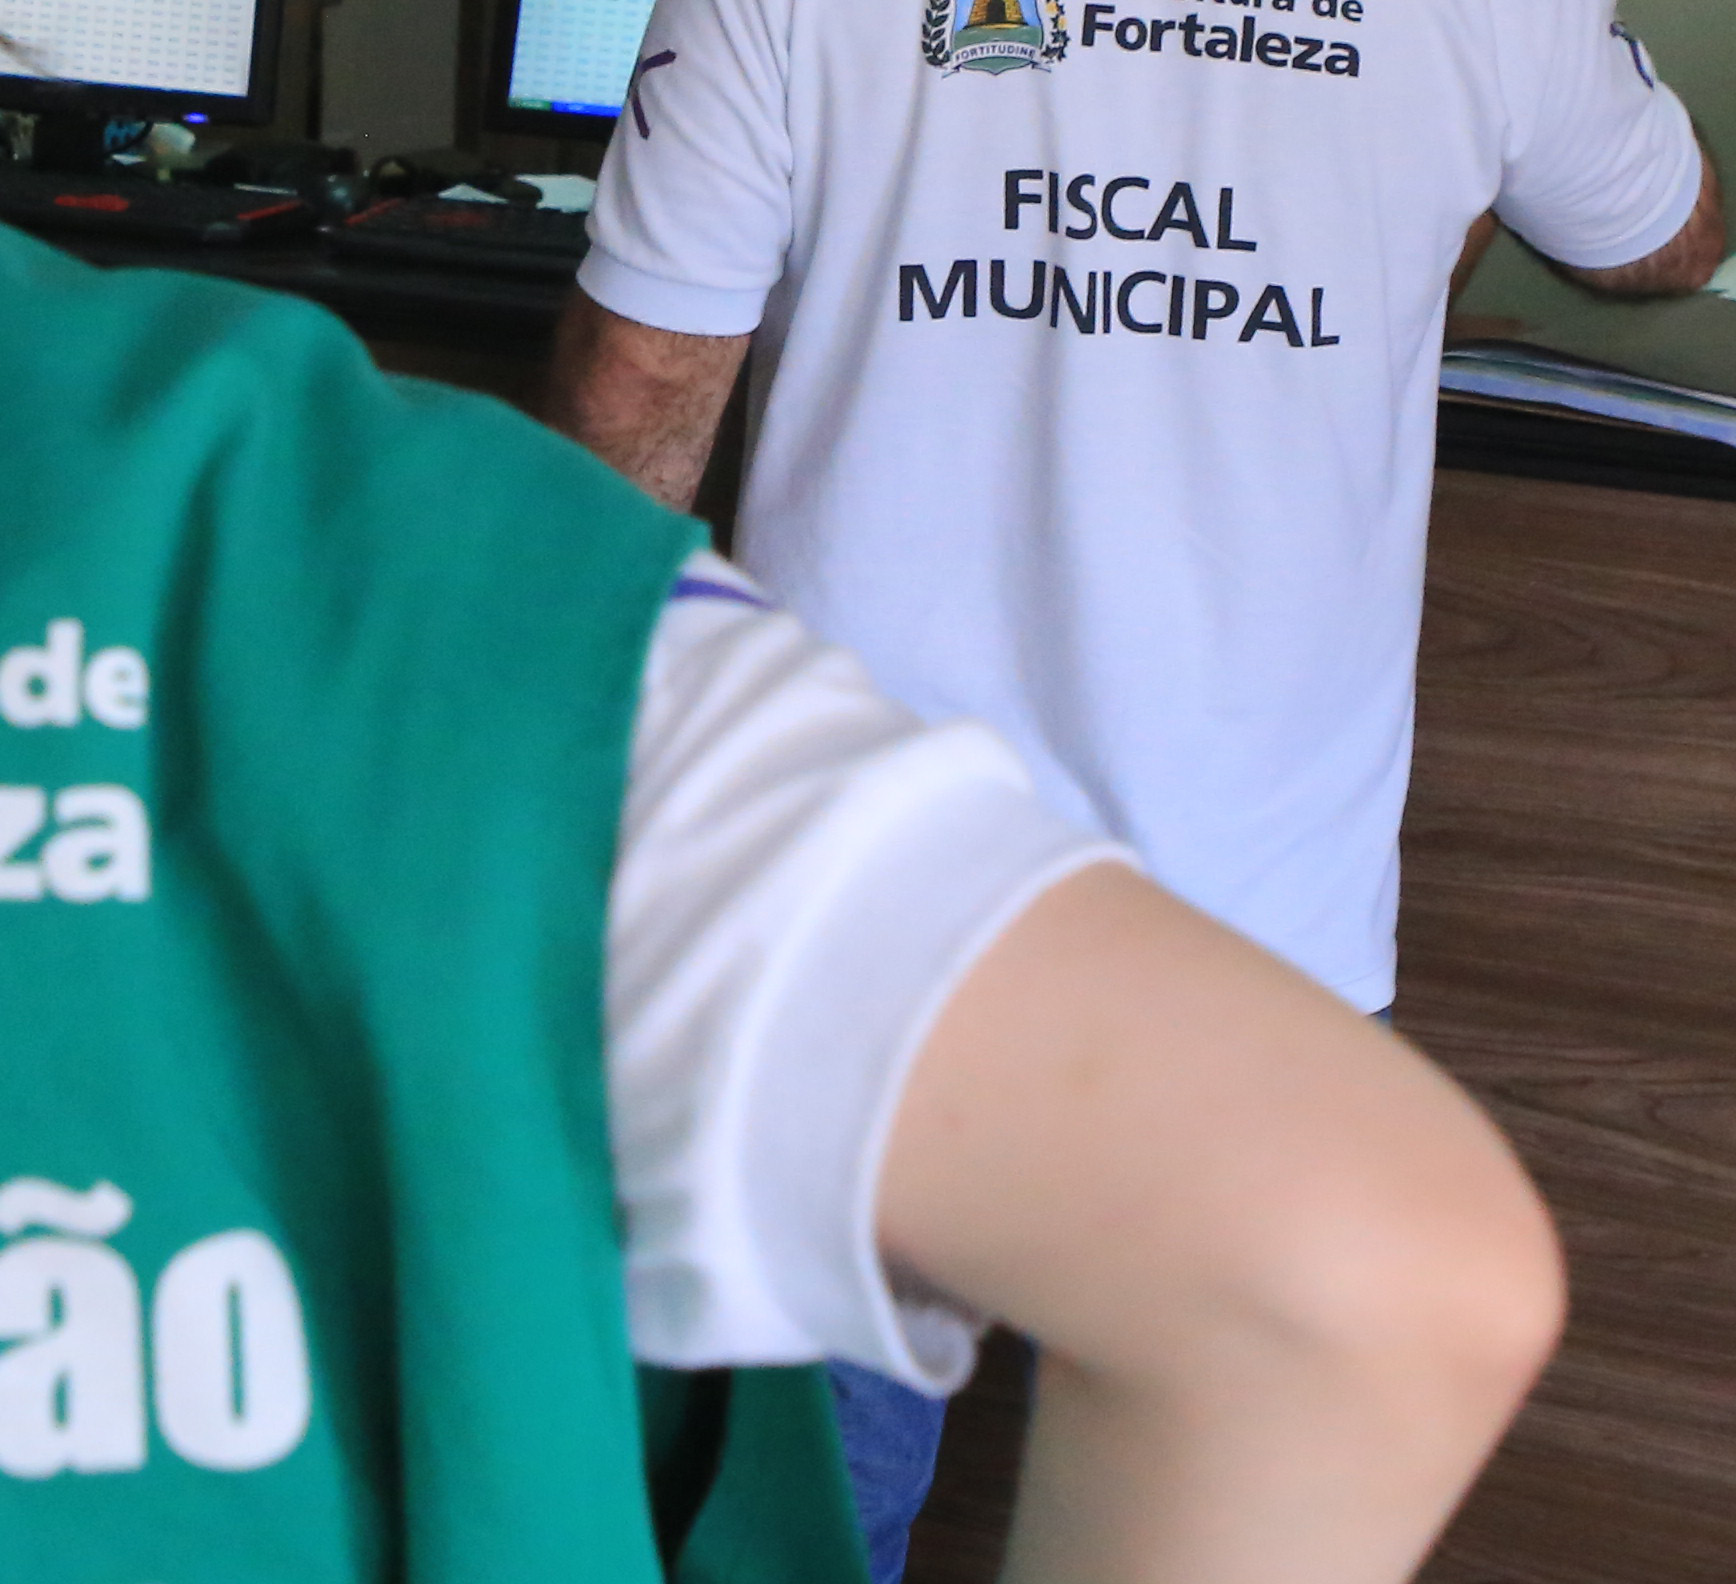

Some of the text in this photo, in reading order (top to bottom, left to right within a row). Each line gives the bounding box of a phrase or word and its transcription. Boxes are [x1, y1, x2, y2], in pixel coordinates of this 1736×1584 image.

[954, 43, 1037, 61] FORTITUDINE
[1080, 3, 1362, 78] Fortaleza
[1003, 168, 1259, 253] FISCAL
[897, 259, 1341, 349] MUNICIPAL
